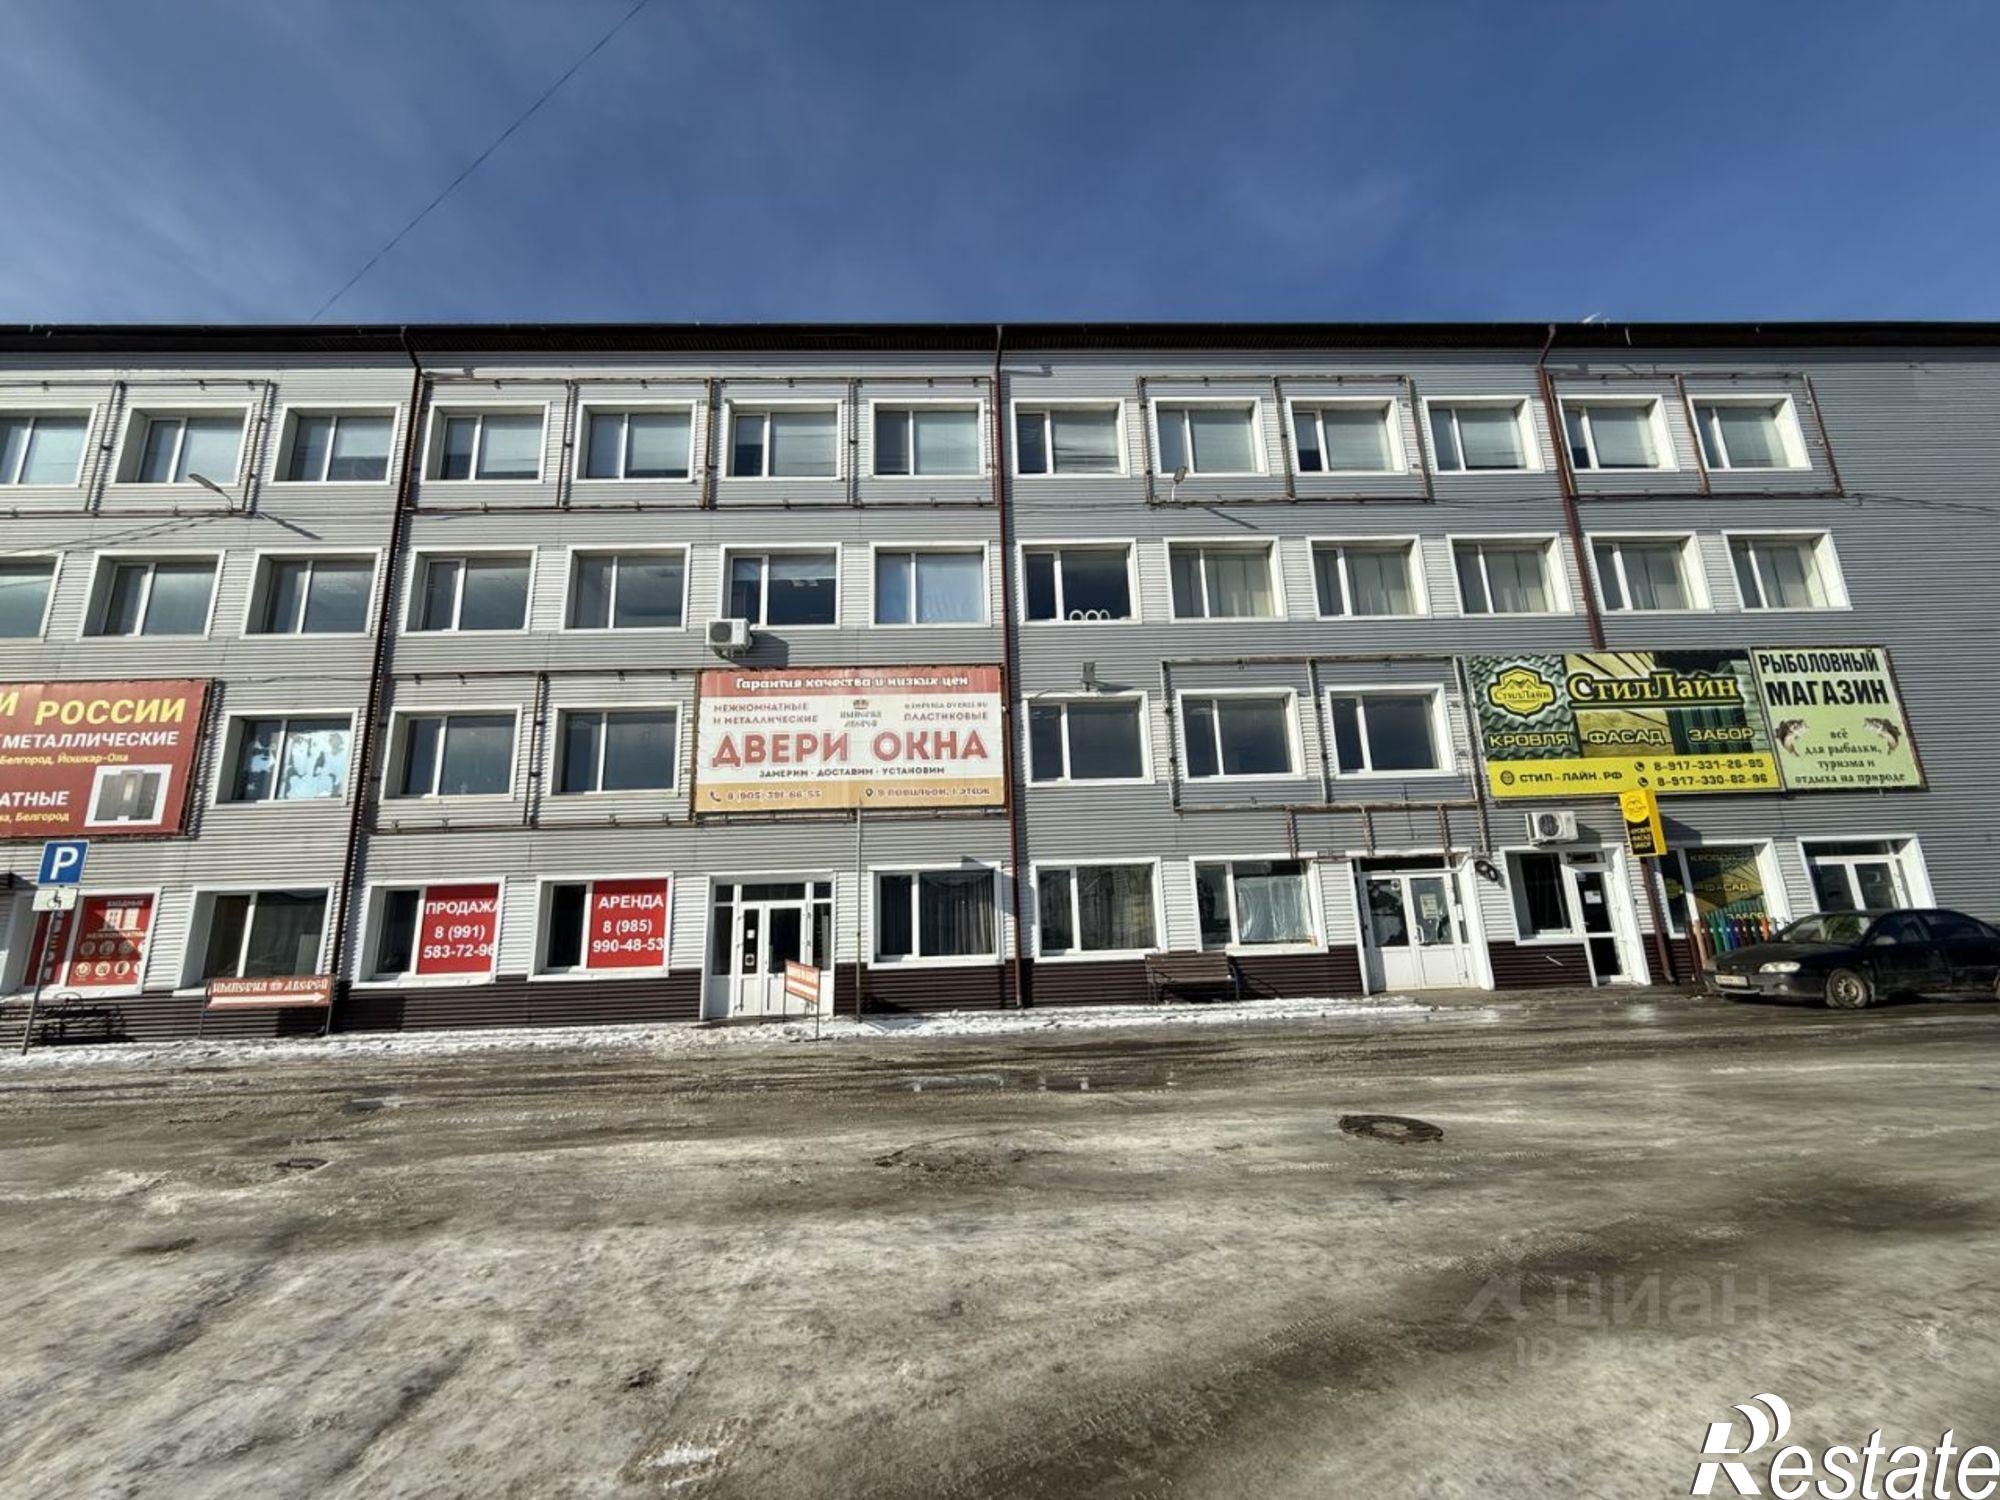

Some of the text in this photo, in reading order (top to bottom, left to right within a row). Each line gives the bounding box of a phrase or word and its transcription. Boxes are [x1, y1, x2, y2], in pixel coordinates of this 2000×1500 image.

[1759, 651, 1880, 673] РЫБОЛОВНЫЙ
[736, 676, 968, 690] Гарантия качества и низких цен
[1569, 672, 1737, 701] СтилЛайн
[1766, 680, 1889, 706] МАГАЗИН
[34, 698, 186, 726] РОССИИ
[713, 702, 808, 712] МЕЖКОМНАТНЫЕ
[713, 715, 818, 725] И МЕТАЛЛИЧЕСКИЕ
[904, 711, 989, 721] ПЛАСТИКОВЫЕ
[2, 731, 180, 749] МЕТАЛЛИЧЕСКИЕ
[1489, 732, 1570, 747] КРОВЛЯ
[1588, 730, 1666, 746] ФАСАД
[1688, 728, 1754, 742] ЗАБОР
[1830, 728, 1848, 739] всё
[711, 730, 989, 768] ДВЕРИ ОКНА
[1805, 746, 1826, 755] для
[759, 766, 945, 778] ЗАМЕРИМ ДОСТАВИМ УСТАНОВИМ
[1818, 760, 1865, 772] туризма
[1796, 773, 1905, 784] отдыха на природе
[50, 846, 78, 879] P
[598, 895, 664, 909] АРЕНДА
[435, 924, 485, 941] 8 (991)
[603, 919, 652, 935] 8 (985)
[423, 945, 494, 959] 583-72-96
[593, 938, 664, 953] 990-48-53
